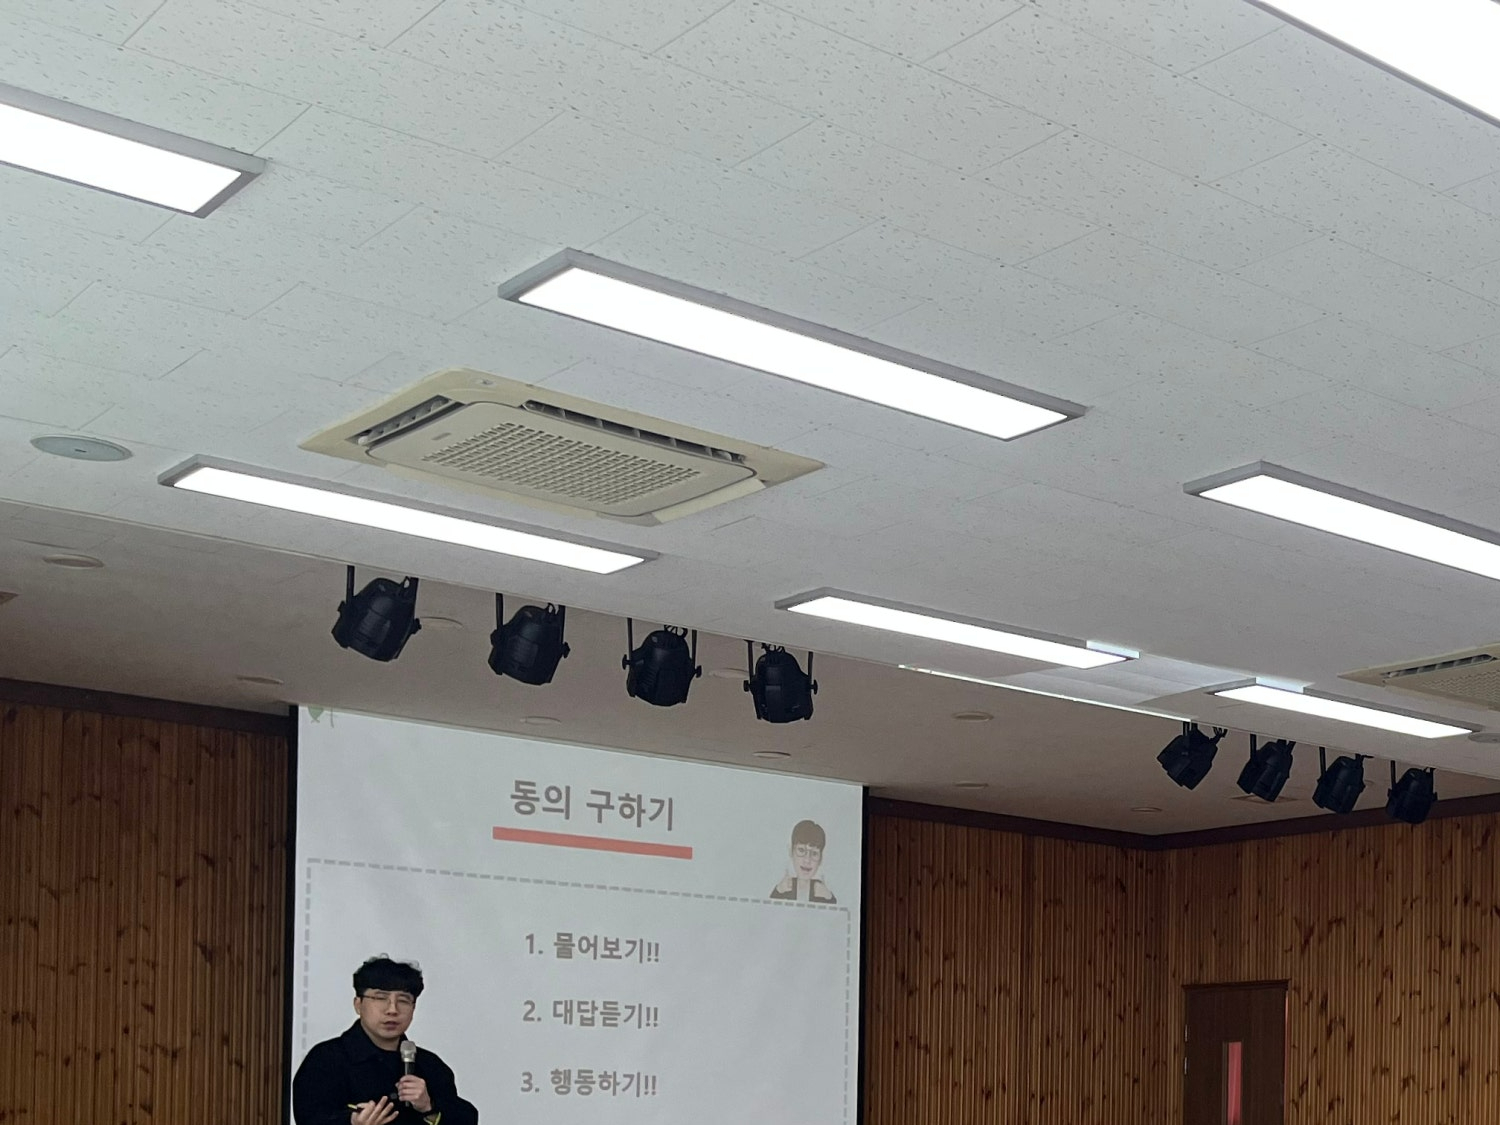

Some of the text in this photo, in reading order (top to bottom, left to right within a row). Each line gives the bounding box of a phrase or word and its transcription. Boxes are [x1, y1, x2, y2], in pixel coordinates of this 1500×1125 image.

[510, 779, 674, 832] 동의 구하기
[526, 932, 660, 963] 1. 물어보기!!
[522, 999, 660, 1029] 2. 대답듣기!!
[520, 1068, 658, 1098] 3. 행동하기!!
